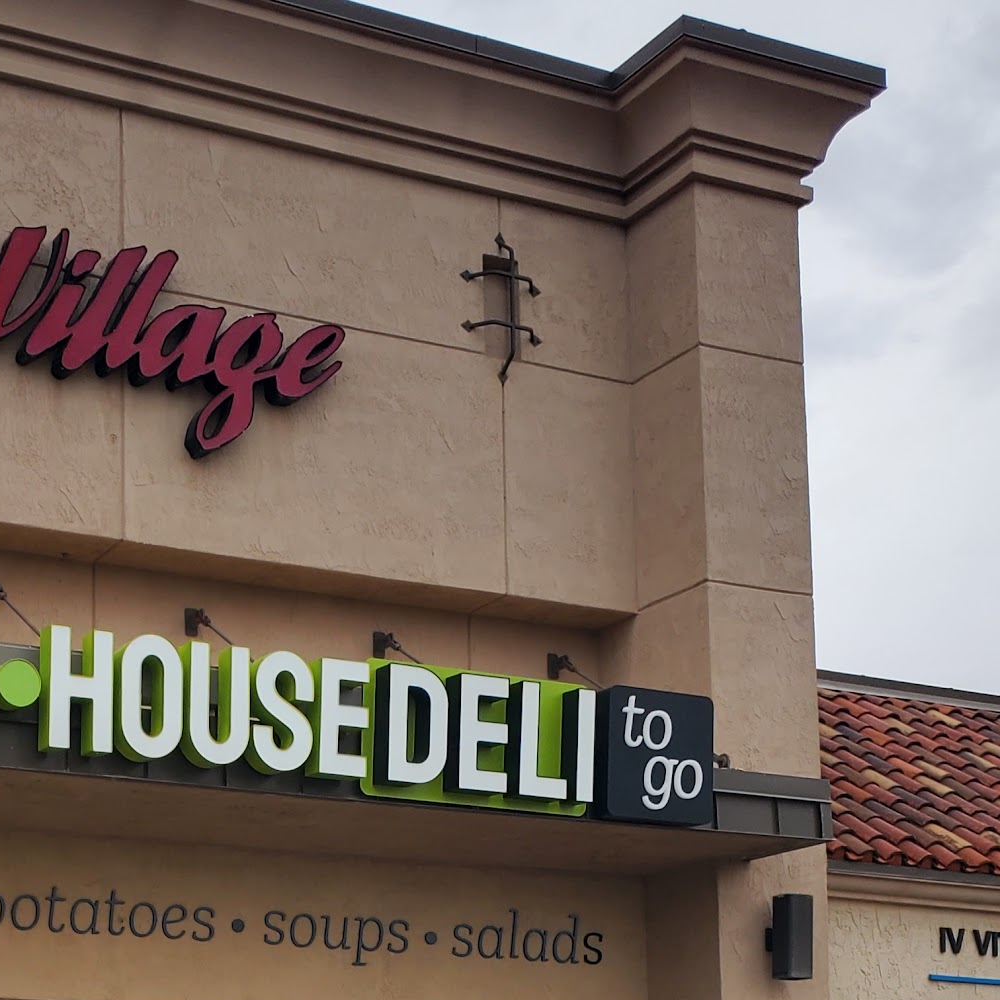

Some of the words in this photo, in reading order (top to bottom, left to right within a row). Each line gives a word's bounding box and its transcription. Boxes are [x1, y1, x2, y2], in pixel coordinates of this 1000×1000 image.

[38, 624, 370, 779] HOUSE
[374, 662, 597, 803] DELI
[621, 694, 673, 751] to
[641, 754, 704, 811] go
[262, 909, 410, 967] soups
[450, 908, 604, 965] salads
[939, 927, 965, 955] IV
